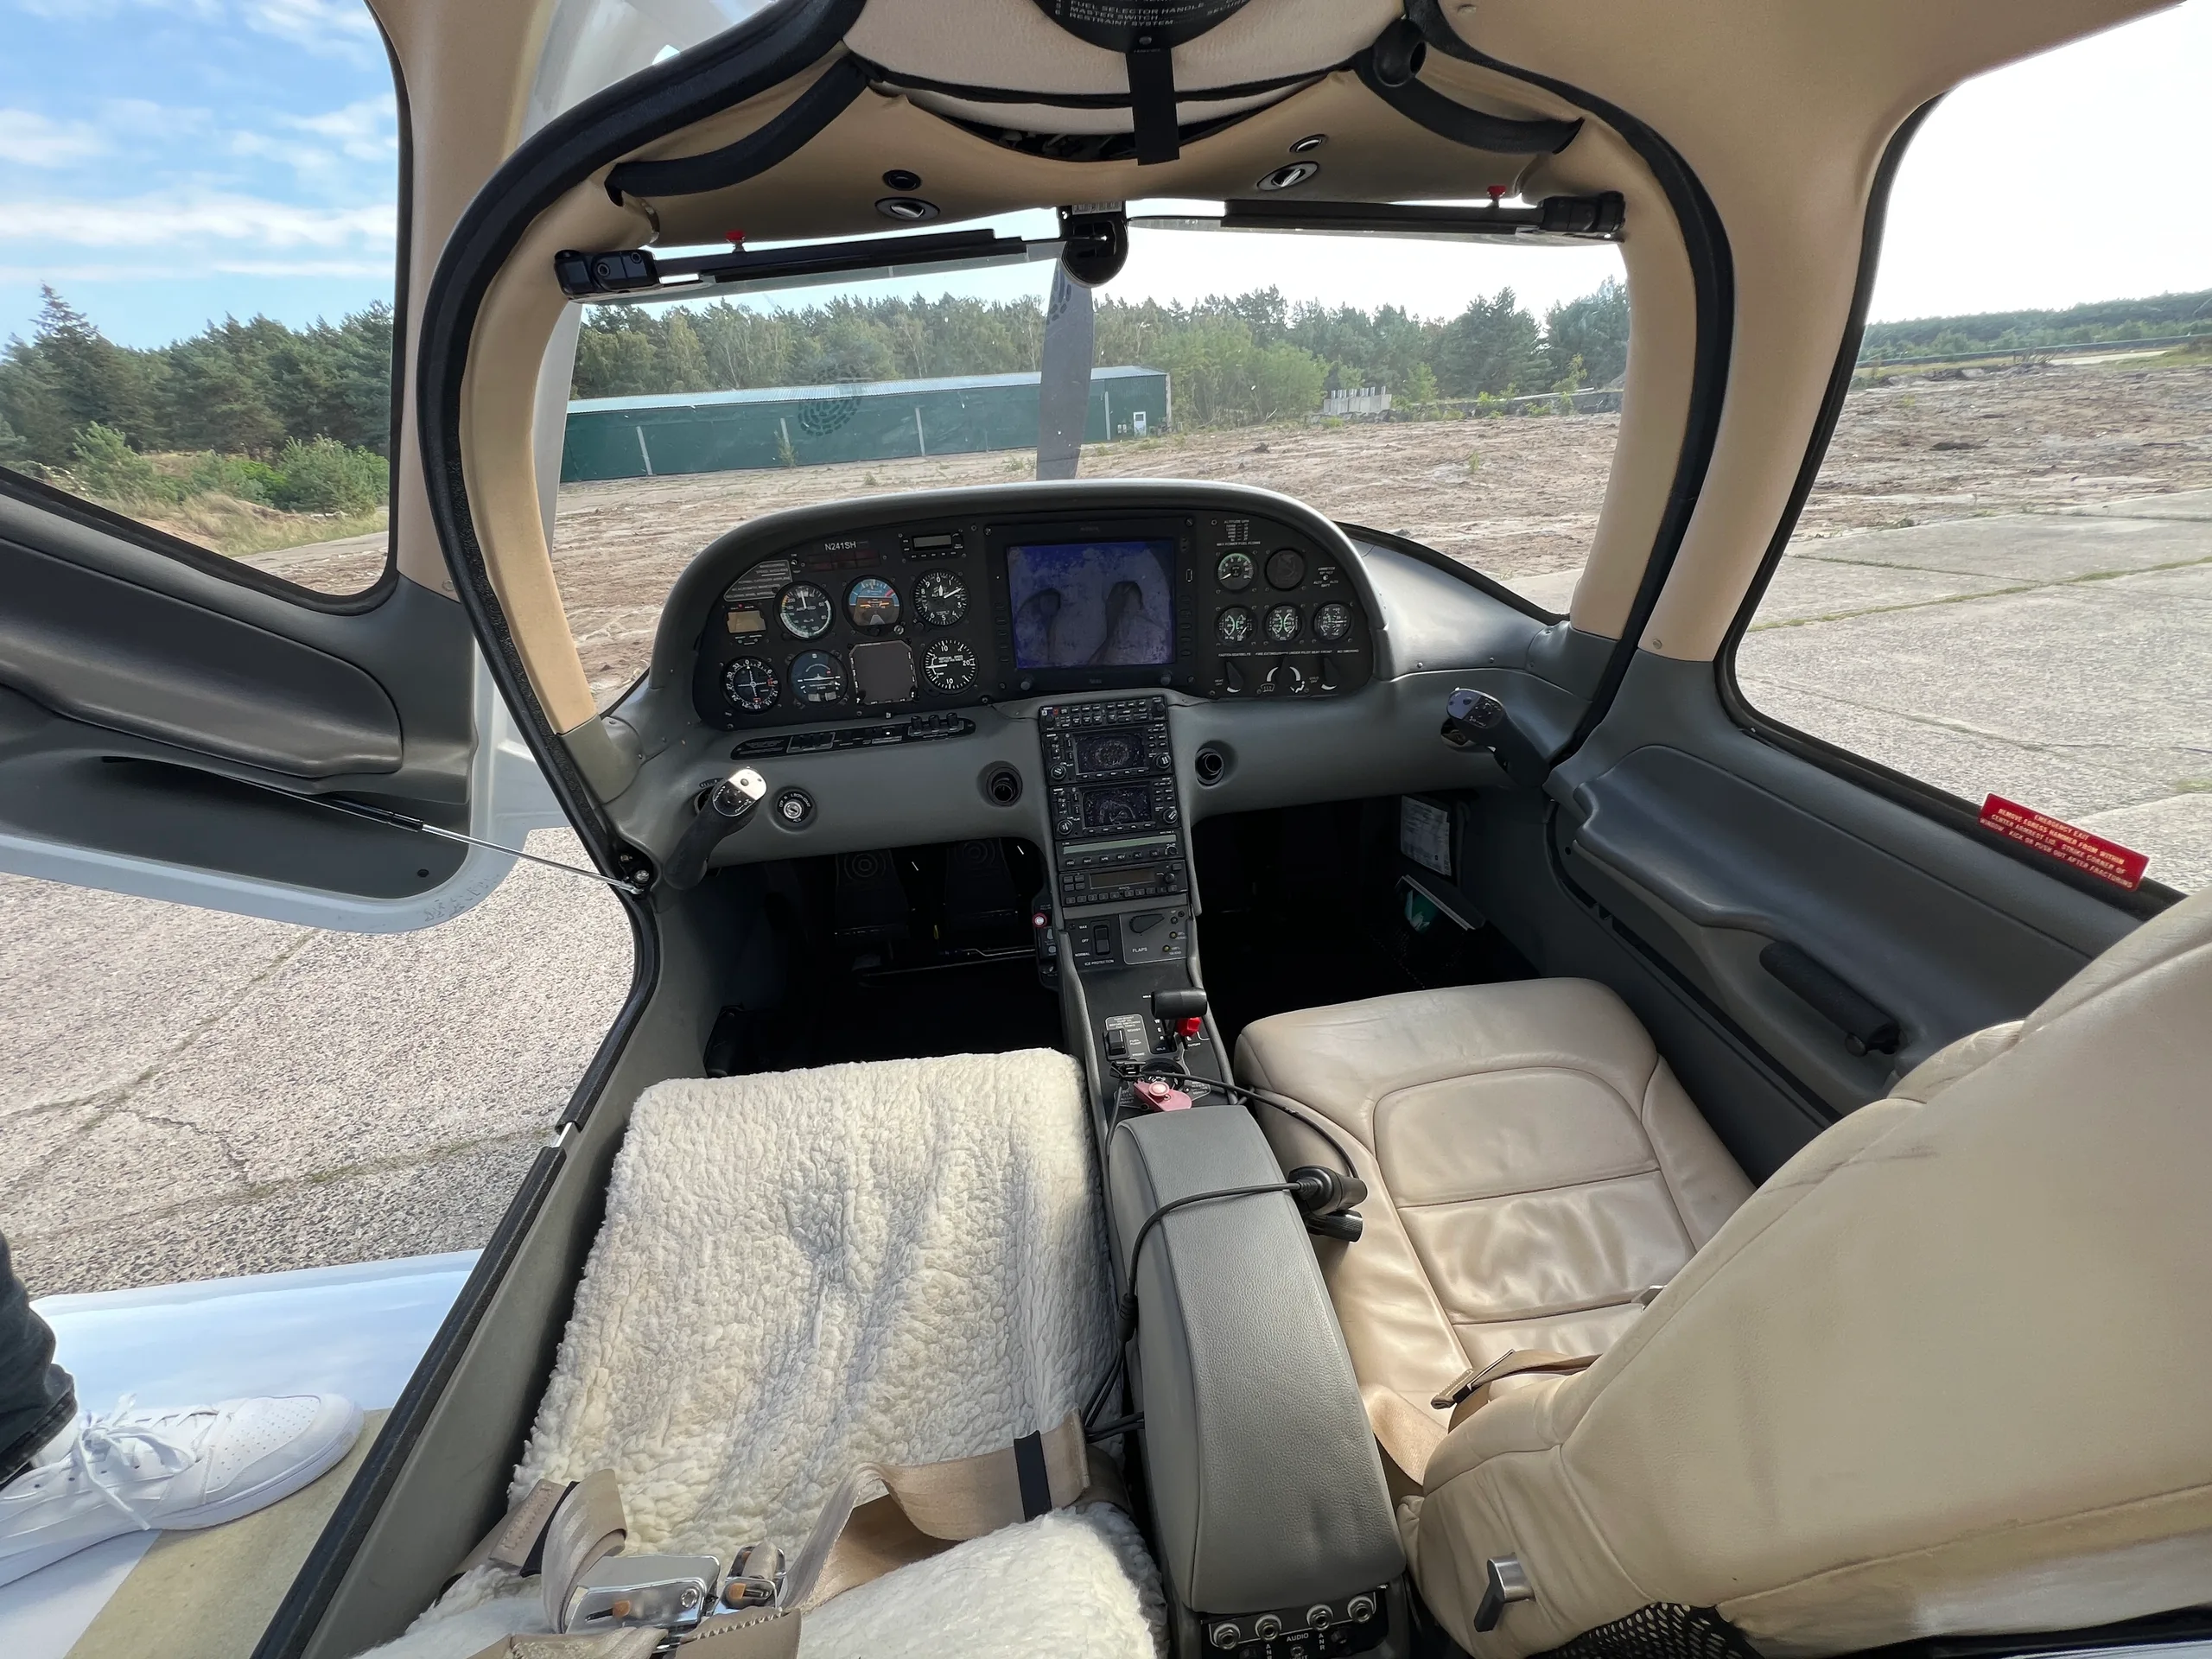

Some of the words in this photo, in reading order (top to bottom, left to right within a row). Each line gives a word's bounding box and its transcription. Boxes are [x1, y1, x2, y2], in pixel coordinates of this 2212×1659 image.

[1071, 7, 1115, 18] MASTER
[1102, 5, 1158, 16] SELECTOR
[1161, 2, 1205, 15] HANDLE
[1070, 12, 1127, 26] RESTRAINT
[1131, 19, 1174, 28] SYSTEM
[824, 541, 856, 550] N241SH
[2034, 814, 2073, 834] EMERGENCY
[2072, 829, 2090, 841] EXIT
[1991, 814, 2014, 828] CENTER
[2015, 823, 2044, 841] ARMREST
[2061, 843, 2086, 858] STRIKE
[2086, 854, 2114, 871] CORNER
[2115, 866, 2126, 874] OF
[1998, 808, 2023, 823] REMOVE
[2049, 829, 2077, 846] HAMMER
[2078, 842, 2099, 855] FROM
[2099, 850, 2125, 865] WITHIN
[2008, 830, 2024, 841] KICK
[2024, 837, 2035, 846] OR
[2034, 842, 2052, 854] PUSH
[2053, 849, 2067, 860] OUT
[2066, 855, 2089, 869] AFTER
[2089, 865, 2133, 889] FRACTURING
[1287, 1633, 1309, 1642] AUDIO
